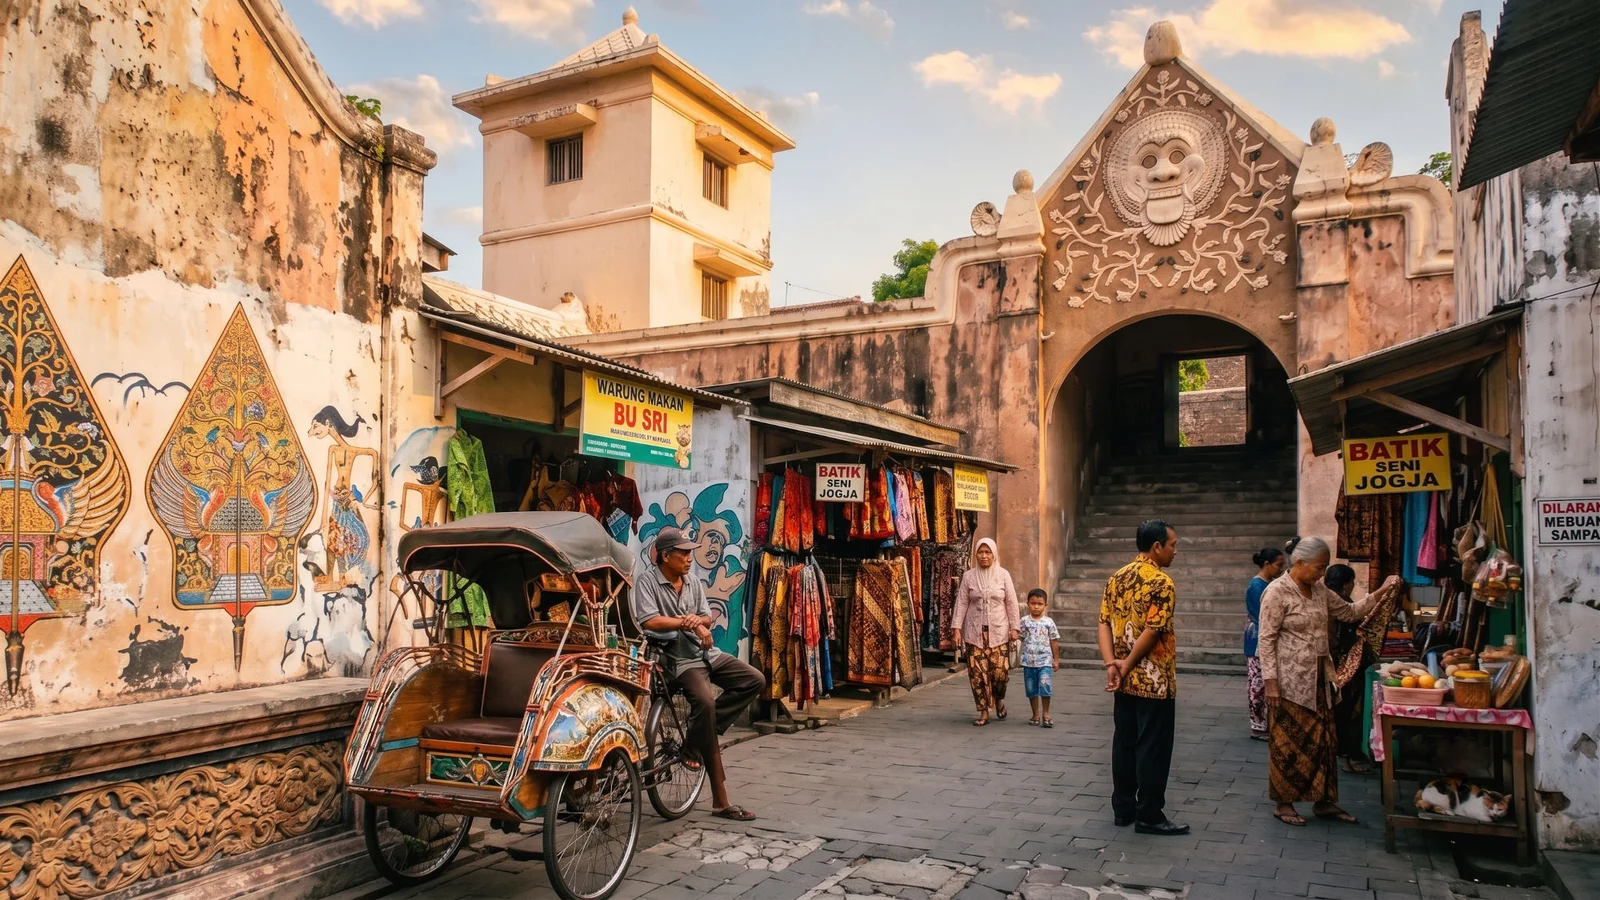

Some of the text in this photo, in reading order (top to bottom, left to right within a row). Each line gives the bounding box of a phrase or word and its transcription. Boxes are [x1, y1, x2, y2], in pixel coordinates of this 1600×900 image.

[597, 378, 684, 412] WARUNG MAKAN
[614, 402, 668, 434] BU SRI
[1349, 438, 1445, 461] BATIK
[818, 466, 861, 478] BATIK
[1376, 460, 1420, 473] SENI
[827, 479, 851, 488] SENI
[1355, 472, 1439, 490] JOGJA
[819, 489, 858, 499] JOGJA
[1551, 529, 1600, 540] SAMPA
